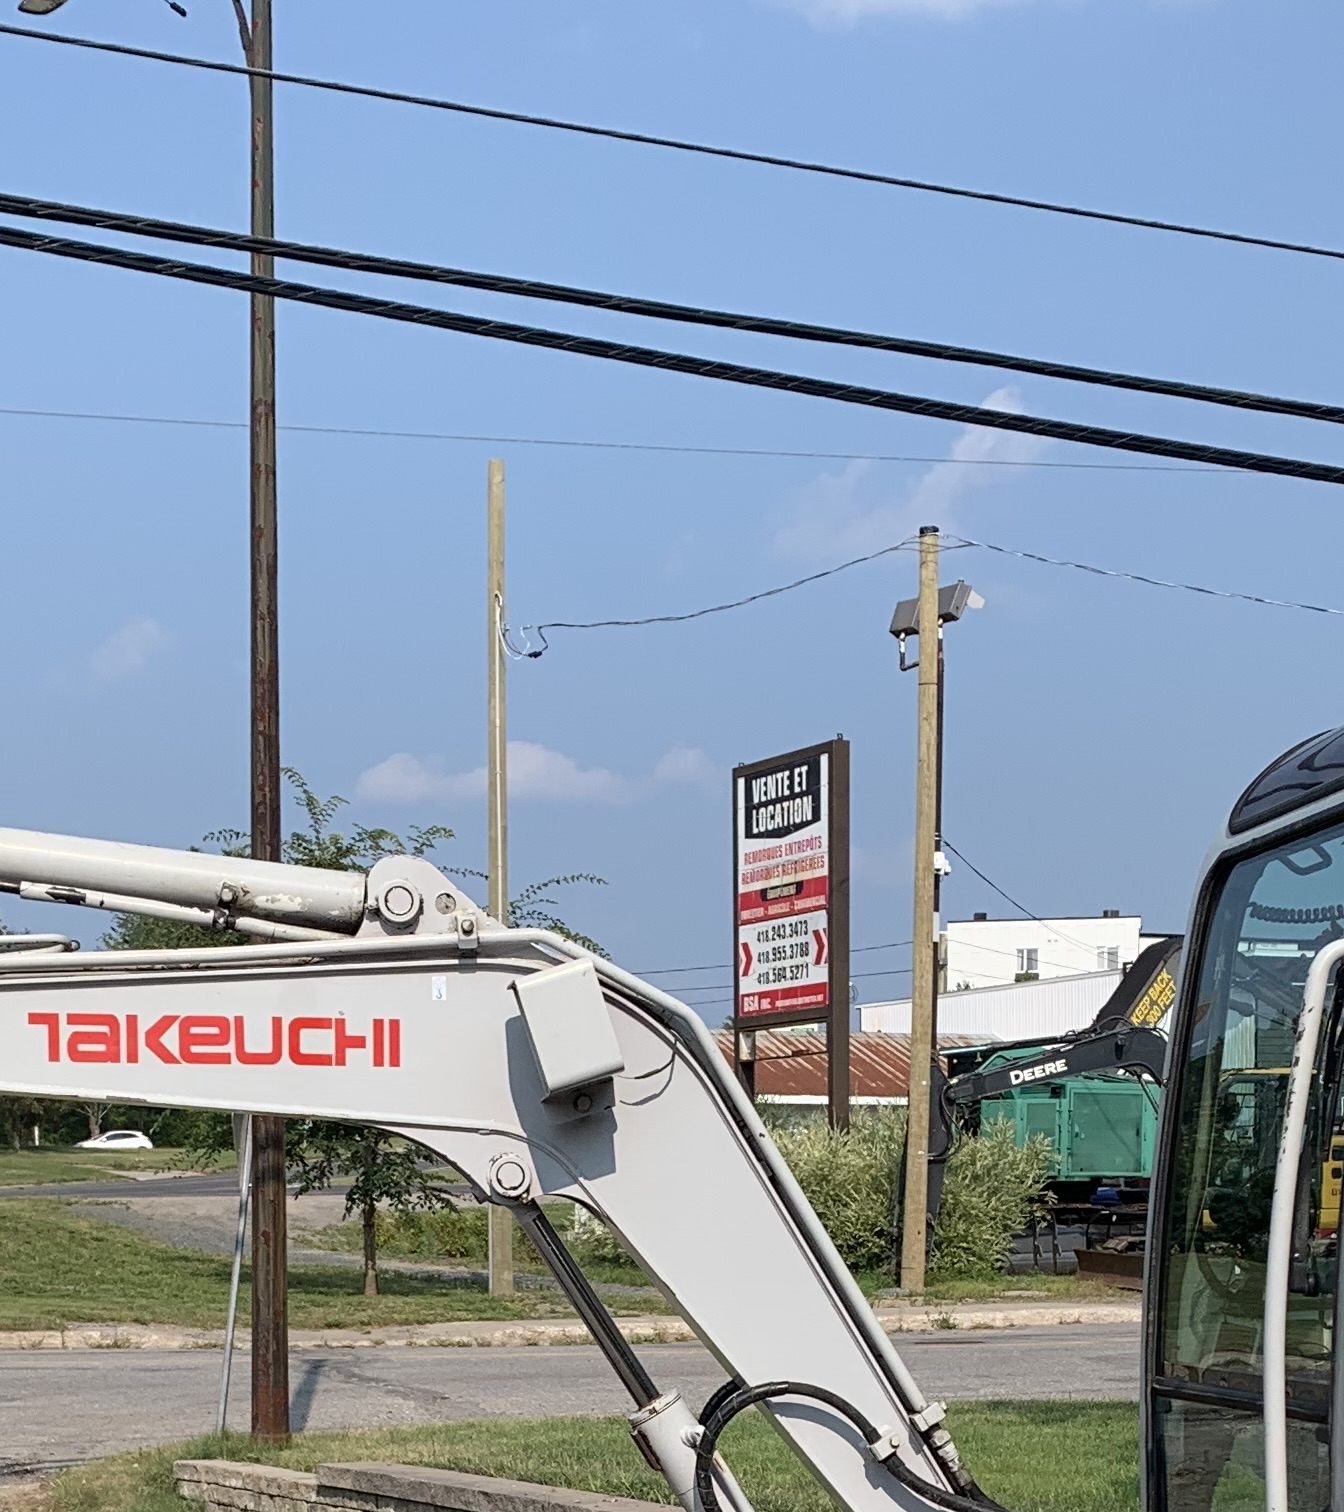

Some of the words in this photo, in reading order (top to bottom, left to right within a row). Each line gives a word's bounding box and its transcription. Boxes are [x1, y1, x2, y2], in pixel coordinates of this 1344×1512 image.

[752, 770, 790, 804] VENTE
[794, 765, 808, 793] ET
[752, 795, 812, 834] LOCATION
[744, 844, 783, 865] REMORQUES
[784, 834, 822, 856] ENTREPÔTS
[742, 864, 781, 885] REMORQUES
[757, 920, 808, 943] 418.243.3473
[757, 942, 809, 964] 418.955.3788
[757, 963, 809, 985] 418.564.5271
[743, 995, 759, 1012] BSA
[1130, 995, 1150, 1026] KEEP
[1148, 968, 1172, 1000] BACK
[1157, 980, 1176, 1010] FEET
[1010, 1059, 1068, 1085] DEERE
